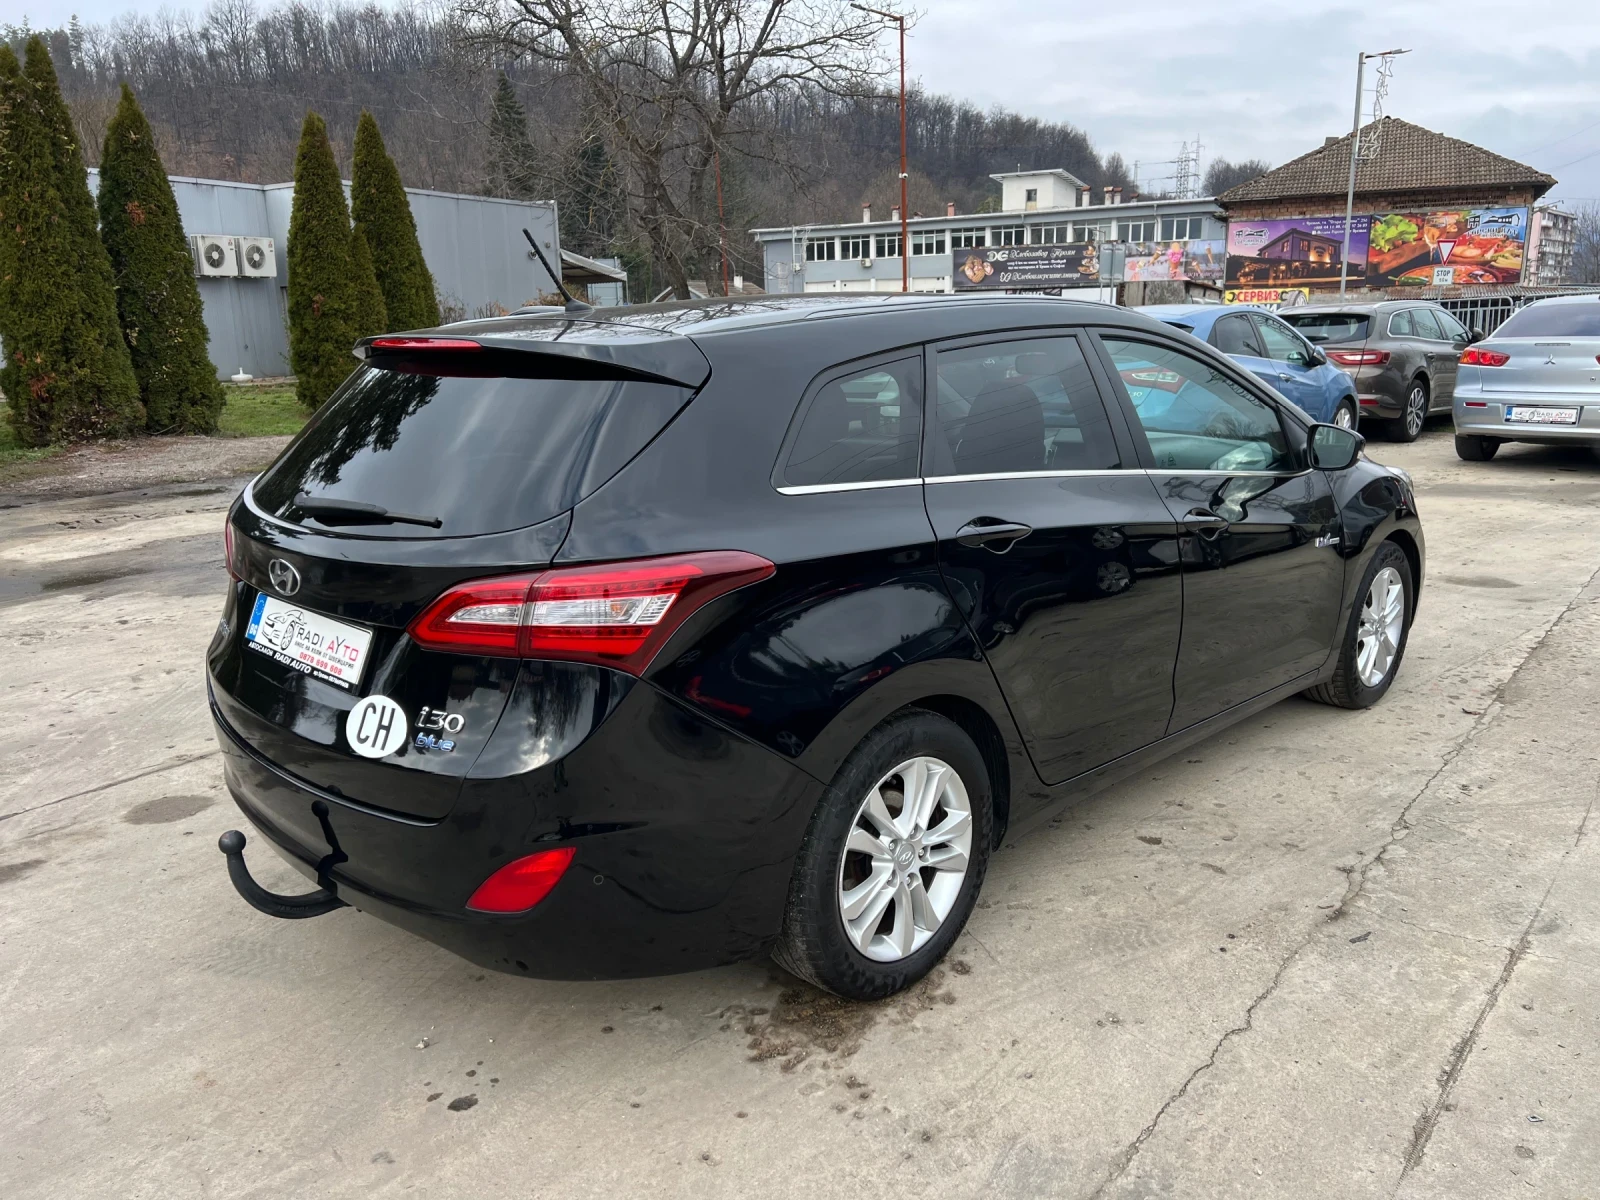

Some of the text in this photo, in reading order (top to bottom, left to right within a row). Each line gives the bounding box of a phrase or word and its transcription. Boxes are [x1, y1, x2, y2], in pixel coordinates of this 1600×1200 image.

[1237, 290, 1279, 303] СЕРВИЗ
[296, 626, 325, 648] RADI
[273, 651, 291, 667] RADI
[289, 659, 312, 674] AUTO
[299, 651, 315, 664] 0878
[356, 701, 396, 752] CH
[415, 706, 465, 734] i30
[414, 731, 455, 752] blue
